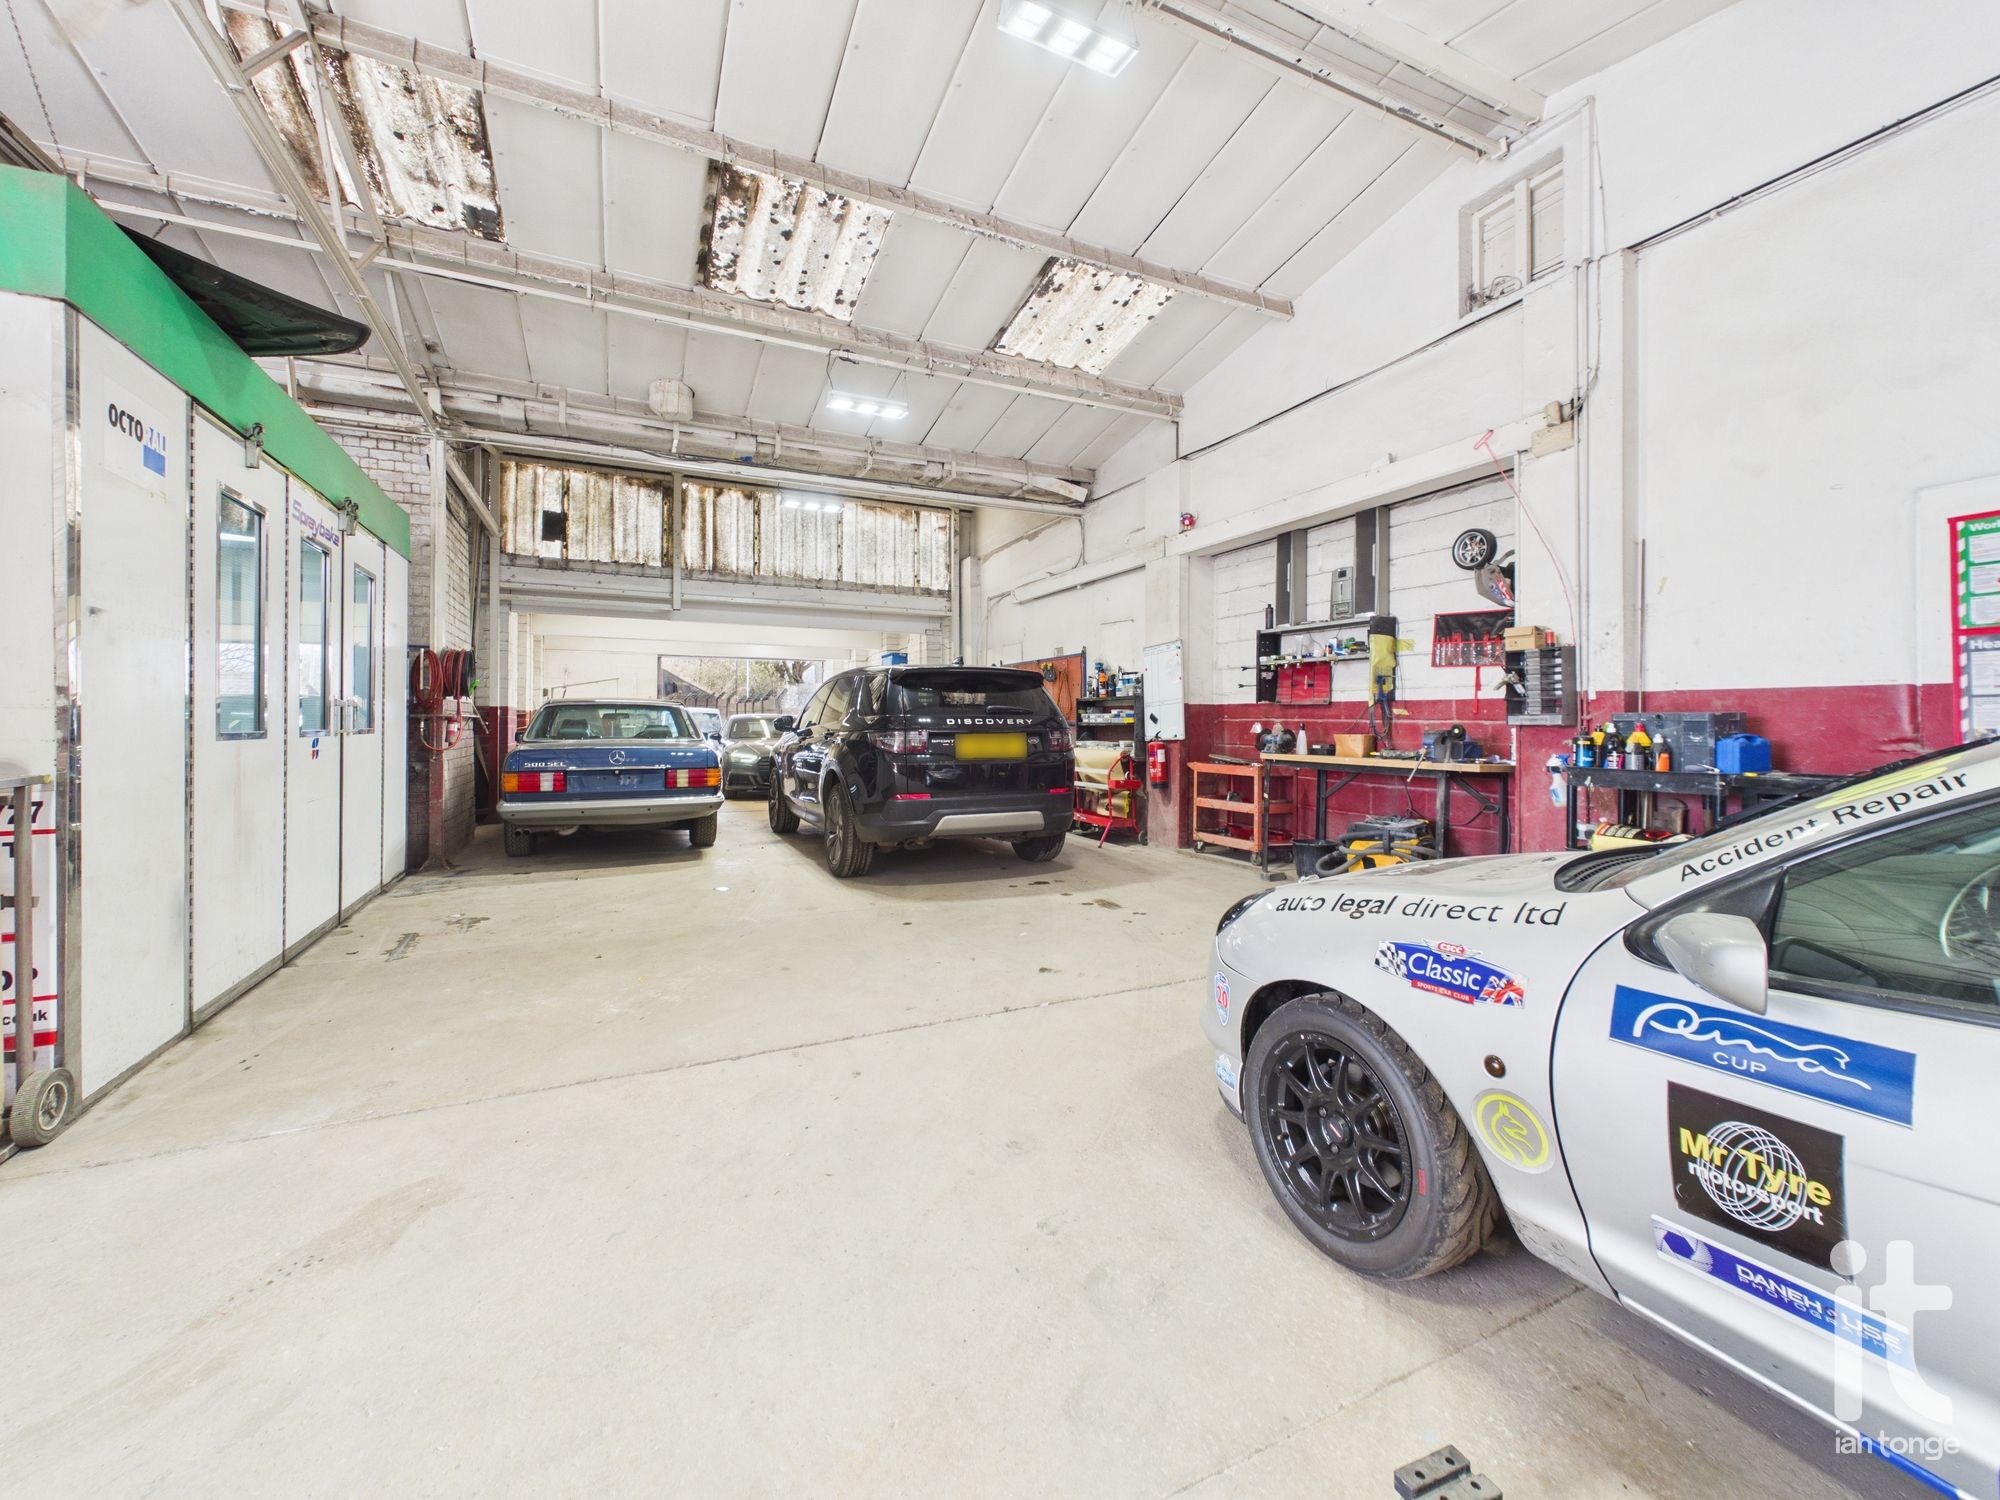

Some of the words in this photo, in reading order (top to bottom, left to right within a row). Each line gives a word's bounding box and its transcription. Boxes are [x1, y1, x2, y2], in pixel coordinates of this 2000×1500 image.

[1680, 817, 1820, 882] Accident
[1832, 771, 1968, 826] Repair
[1276, 894, 1326, 912] auto
[1330, 893, 1399, 919] legal
[1402, 897, 1504, 922] direct
[1513, 902, 1567, 926] ltd
[1408, 953, 1482, 990] Classic
[1417, 981, 1439, 993] SPORTS
[1440, 987, 1452, 996] CAR
[1453, 992, 1470, 1001] CLUB
[1713, 1052, 1767, 1074] CUP
[1680, 1127, 1728, 1167] Mr
[1737, 1148, 1832, 1206] Tyre
[1688, 1161, 1825, 1226] motorsport
